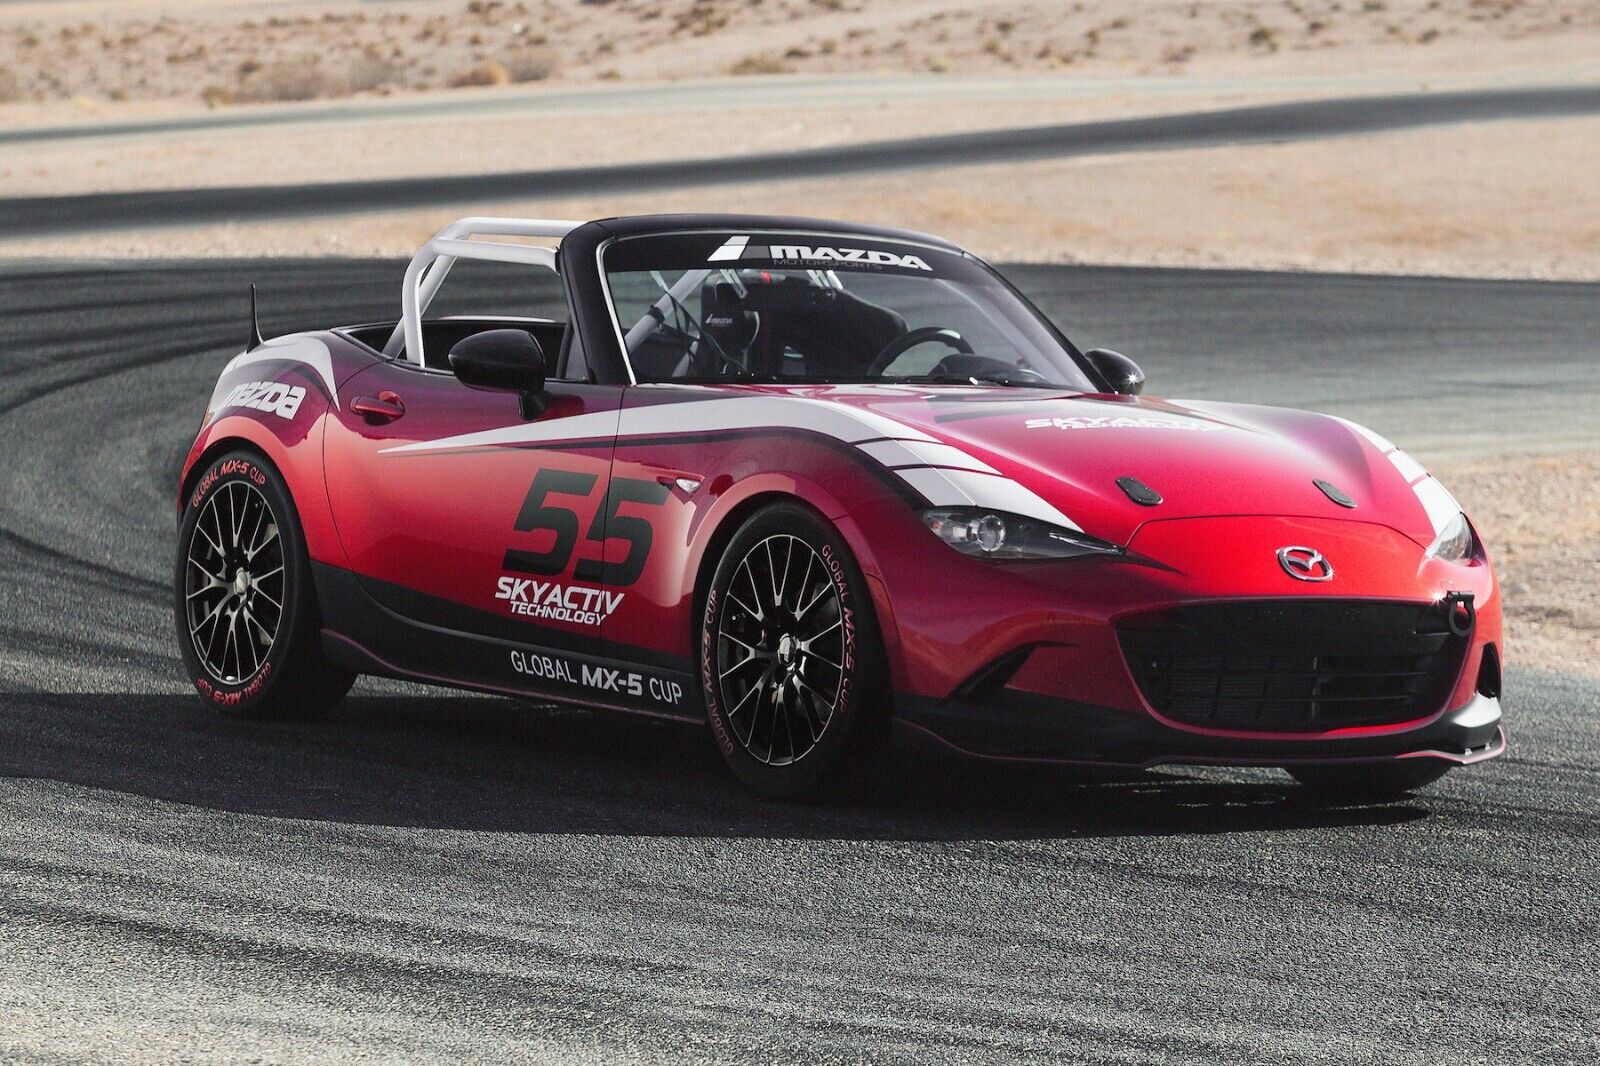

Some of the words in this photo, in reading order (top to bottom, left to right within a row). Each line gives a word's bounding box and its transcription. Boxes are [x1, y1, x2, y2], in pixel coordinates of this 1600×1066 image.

[770, 245, 933, 271] MAZDA
[192, 467, 220, 508] GLOBAL
[220, 459, 251, 476] MX-5
[249, 466, 267, 485] CUP
[501, 468, 671, 587] 55
[494, 576, 625, 615] SKYACTIV
[821, 544, 850, 603] GLOBAL
[510, 600, 606, 626] TECHNOLOGY
[707, 590, 717, 624] CUP
[703, 629, 713, 694] MX-5
[843, 606, 856, 673] MX-5
[197, 677, 212, 697] CUP
[213, 690, 242, 705] MX-5
[510, 650, 578, 684] GLOBAL
[581, 664, 643, 696] MX-5
[649, 677, 683, 705] CUP
[840, 678, 853, 713] CUP
[708, 696, 734, 754] GLOBAL
